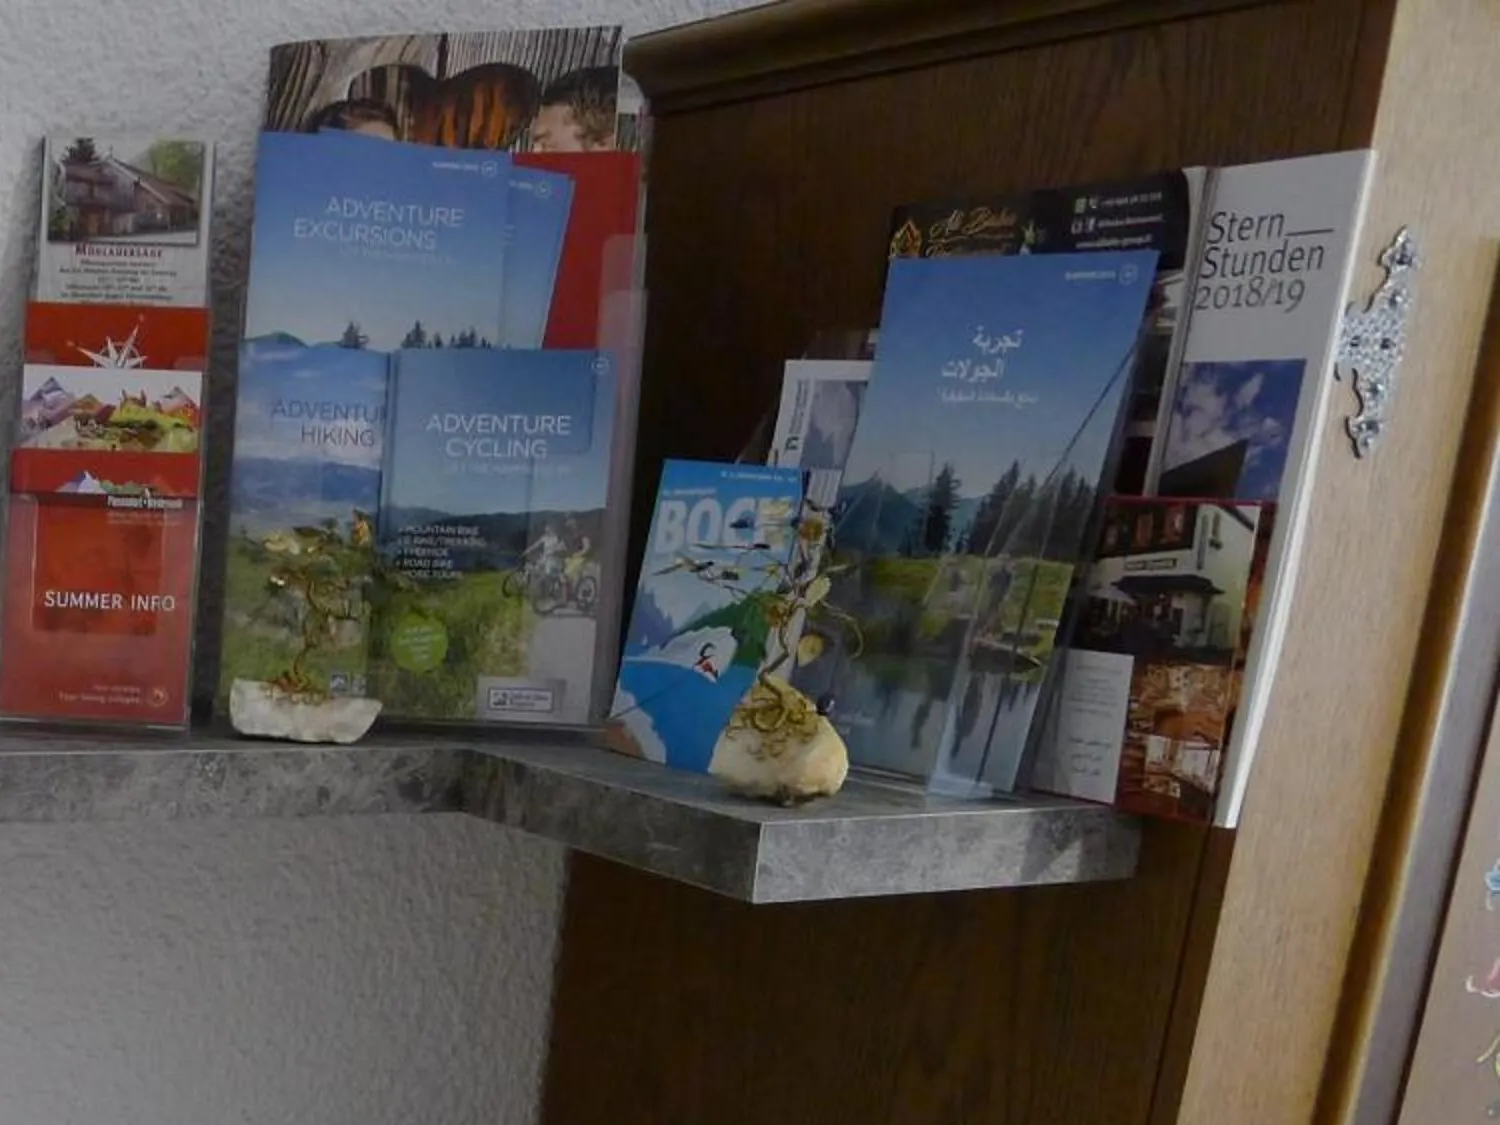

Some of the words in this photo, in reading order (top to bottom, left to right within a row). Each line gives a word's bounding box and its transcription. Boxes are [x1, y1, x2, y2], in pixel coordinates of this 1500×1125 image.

[326, 196, 465, 227] ADVENTURE
[293, 217, 437, 250] EXCURSIONS
[1207, 211, 1285, 244] Stern
[1199, 239, 1325, 279] Stunden
[1193, 275, 1306, 314] 2018/19
[300, 423, 376, 448] HIKING
[425, 412, 572, 436] ADVENTURE
[445, 437, 548, 460] CYCLING
[44, 590, 123, 610] SUMMER
[131, 594, 176, 612] INFO
